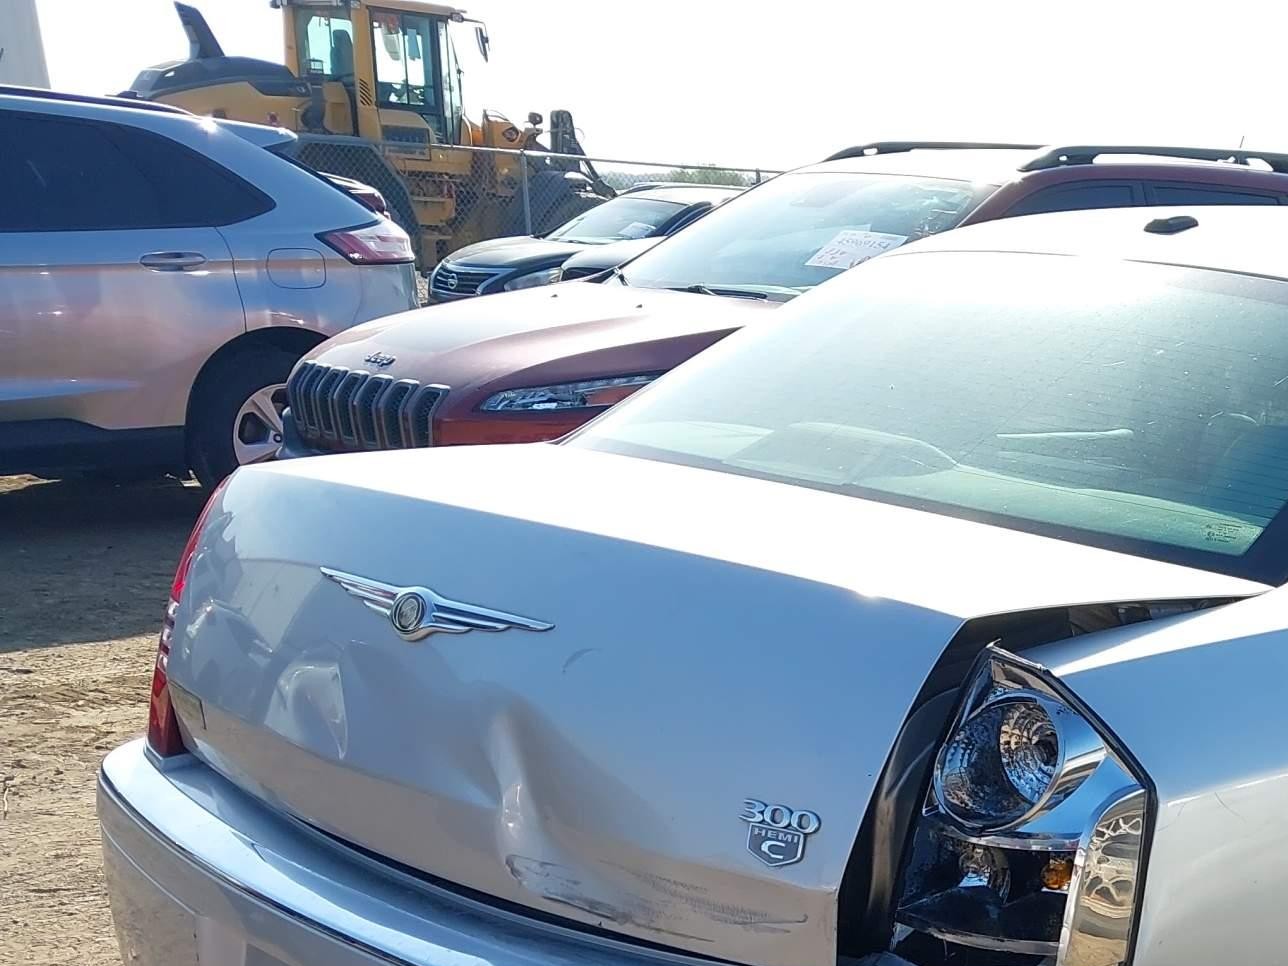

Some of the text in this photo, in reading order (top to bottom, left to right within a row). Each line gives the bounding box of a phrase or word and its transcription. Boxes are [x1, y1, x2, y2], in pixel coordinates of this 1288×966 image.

[364, 351, 396, 367] Jeep
[739, 798, 821, 834] 300
[753, 827, 799, 843] HEMI
[760, 840, 786, 859] C
